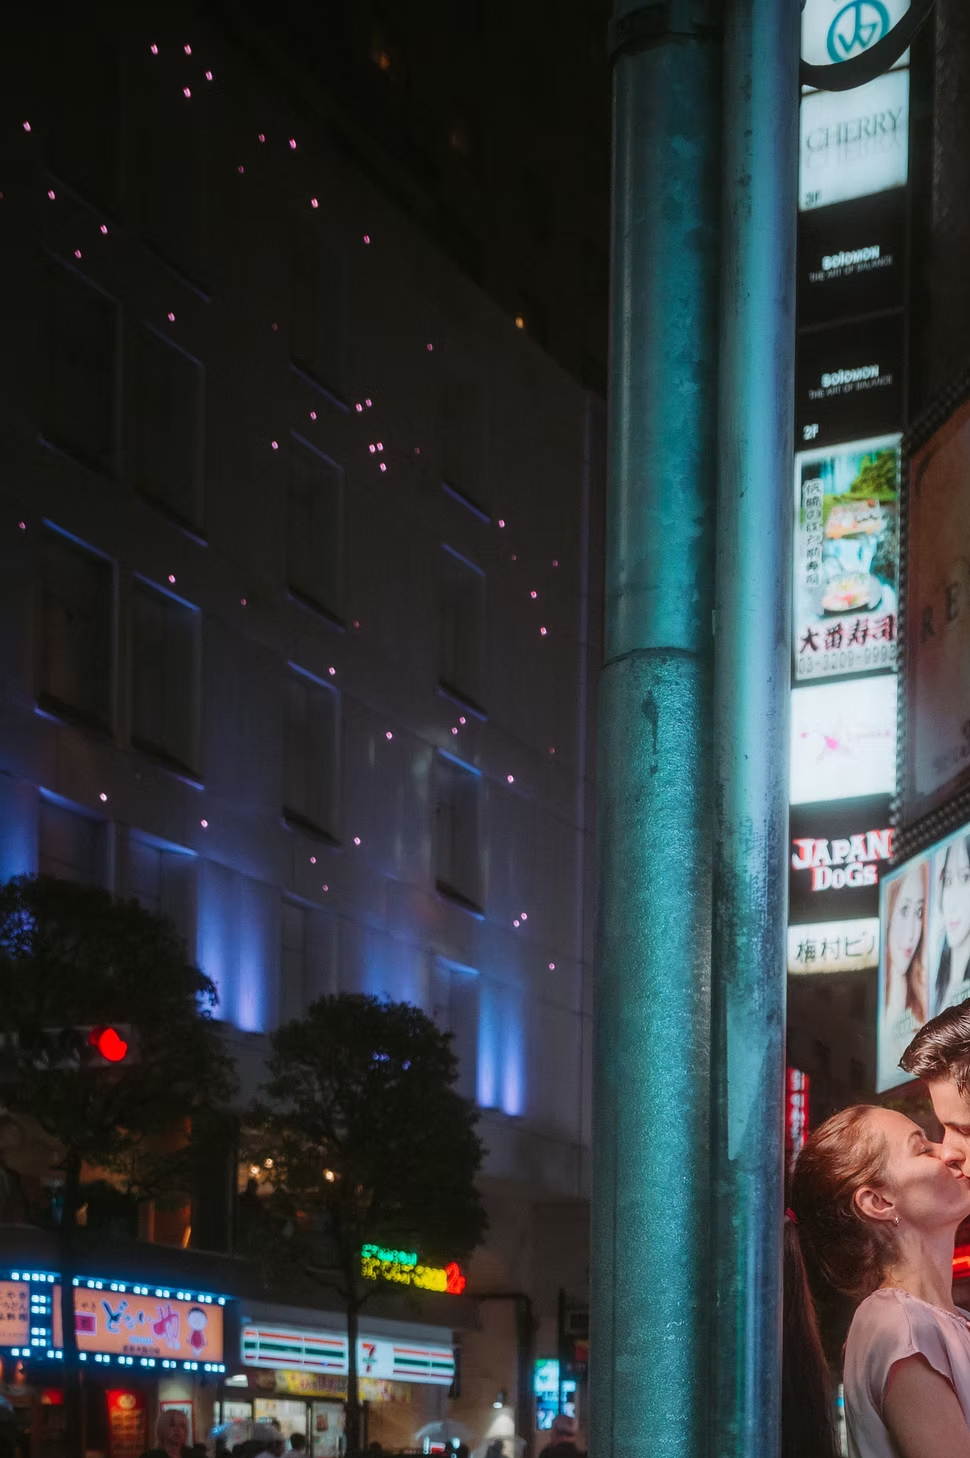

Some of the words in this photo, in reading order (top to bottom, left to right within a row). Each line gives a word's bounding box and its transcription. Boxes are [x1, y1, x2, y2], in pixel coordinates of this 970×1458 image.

[806, 107, 903, 152] CHERRY
[803, 424, 819, 440] 2F
[800, 614, 896, 654] 大番寿司
[792, 828, 895, 870] JAPAN
